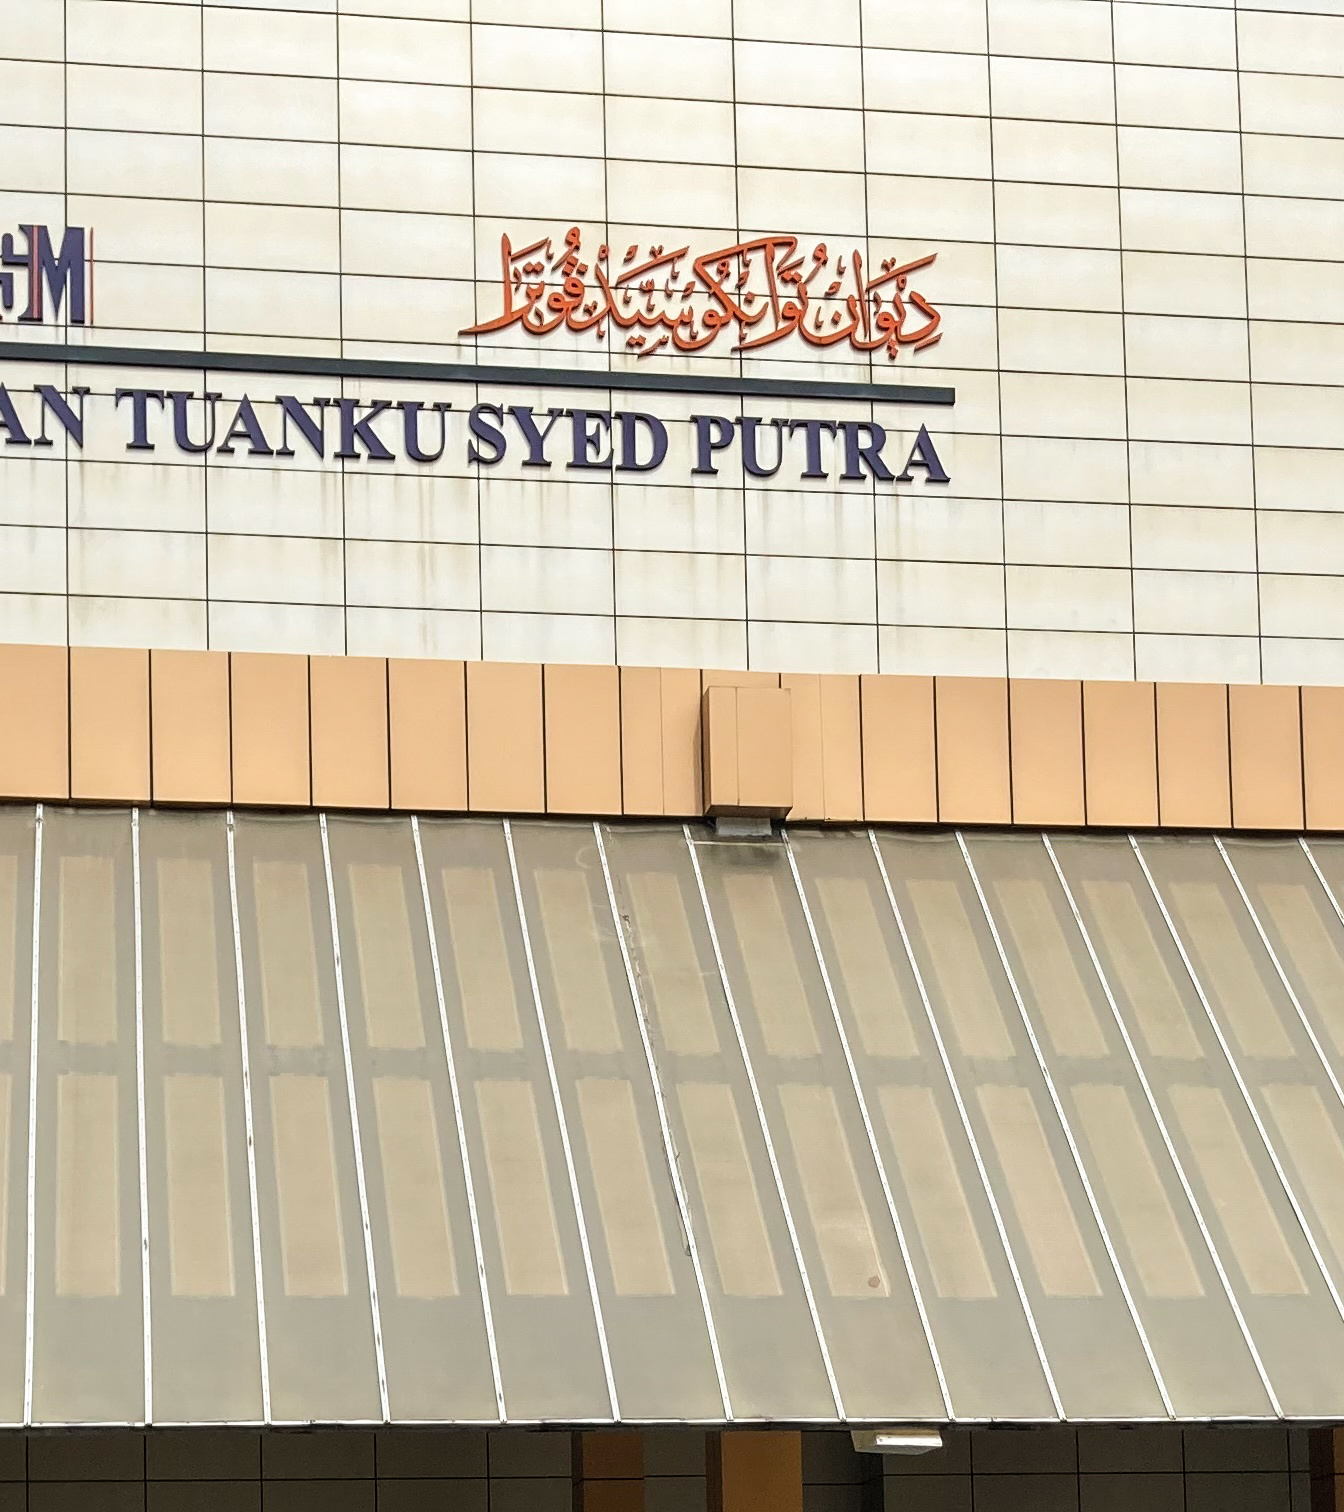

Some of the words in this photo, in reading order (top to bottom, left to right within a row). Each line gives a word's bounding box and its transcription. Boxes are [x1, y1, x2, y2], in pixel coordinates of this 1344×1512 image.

[115, 388, 453, 463] TUANKU
[467, 402, 668, 472] SYED
[690, 414, 952, 483] PUTRA
